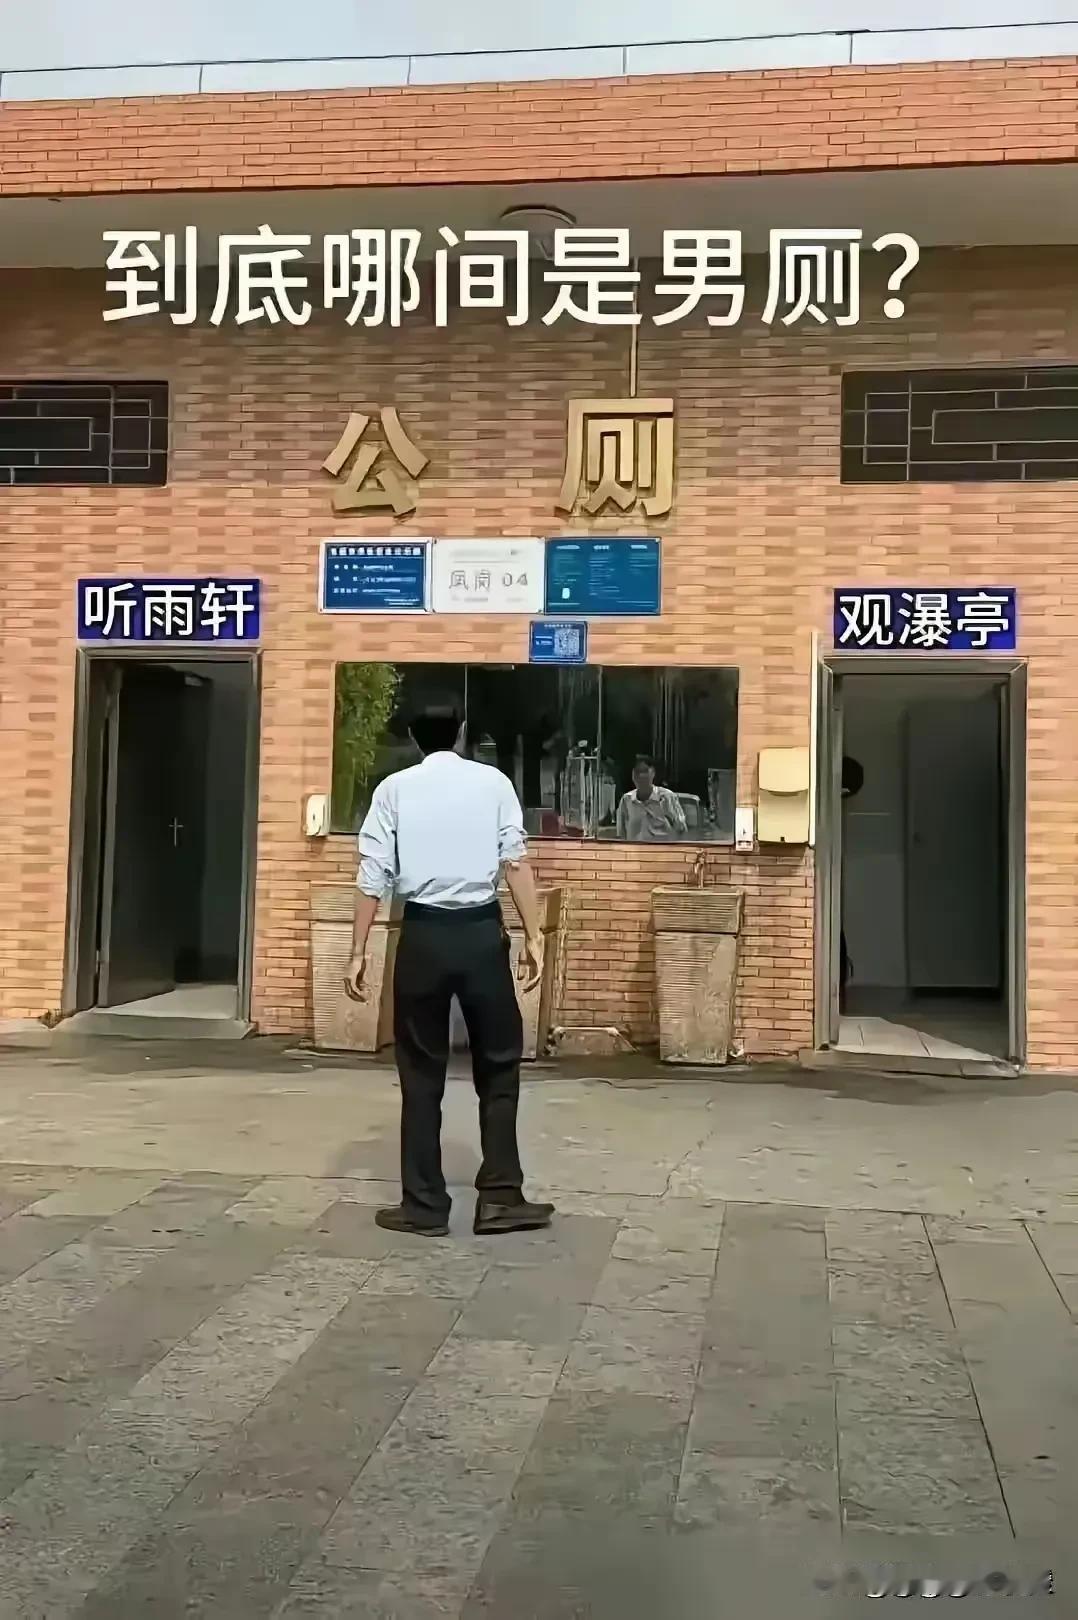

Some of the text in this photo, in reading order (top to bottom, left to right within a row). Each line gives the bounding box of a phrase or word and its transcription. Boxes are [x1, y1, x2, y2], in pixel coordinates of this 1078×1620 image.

[323, 399, 674, 516] 公厕
[85, 583, 254, 636] 听雨轩
[840, 592, 1008, 646] 观瀑亭
